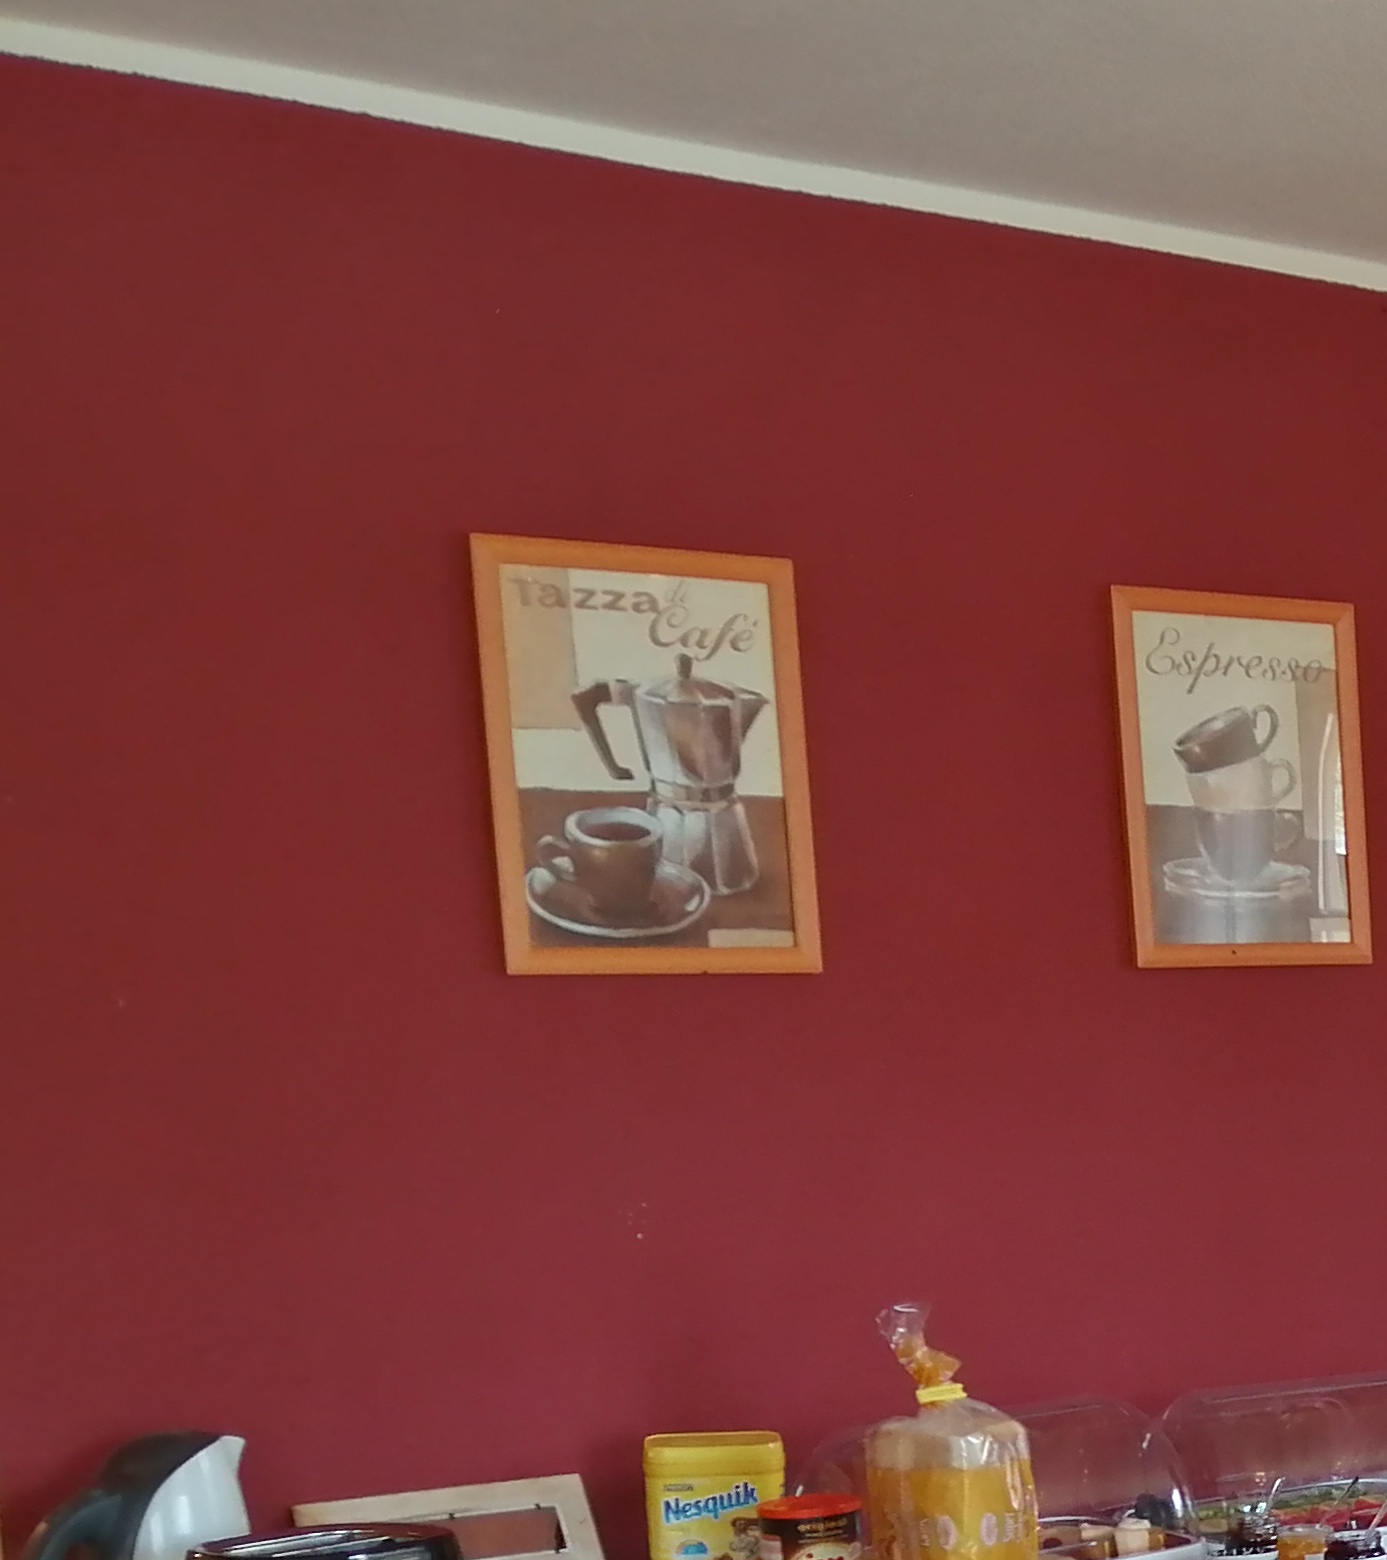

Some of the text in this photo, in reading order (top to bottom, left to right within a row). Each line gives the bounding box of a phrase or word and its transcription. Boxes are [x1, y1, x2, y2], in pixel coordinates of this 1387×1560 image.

[507, 577, 661, 614] Tazza
[649, 604, 758, 661] Café
[1145, 627, 1326, 694] Espresso
[663, 1481, 759, 1525] Nesquik
